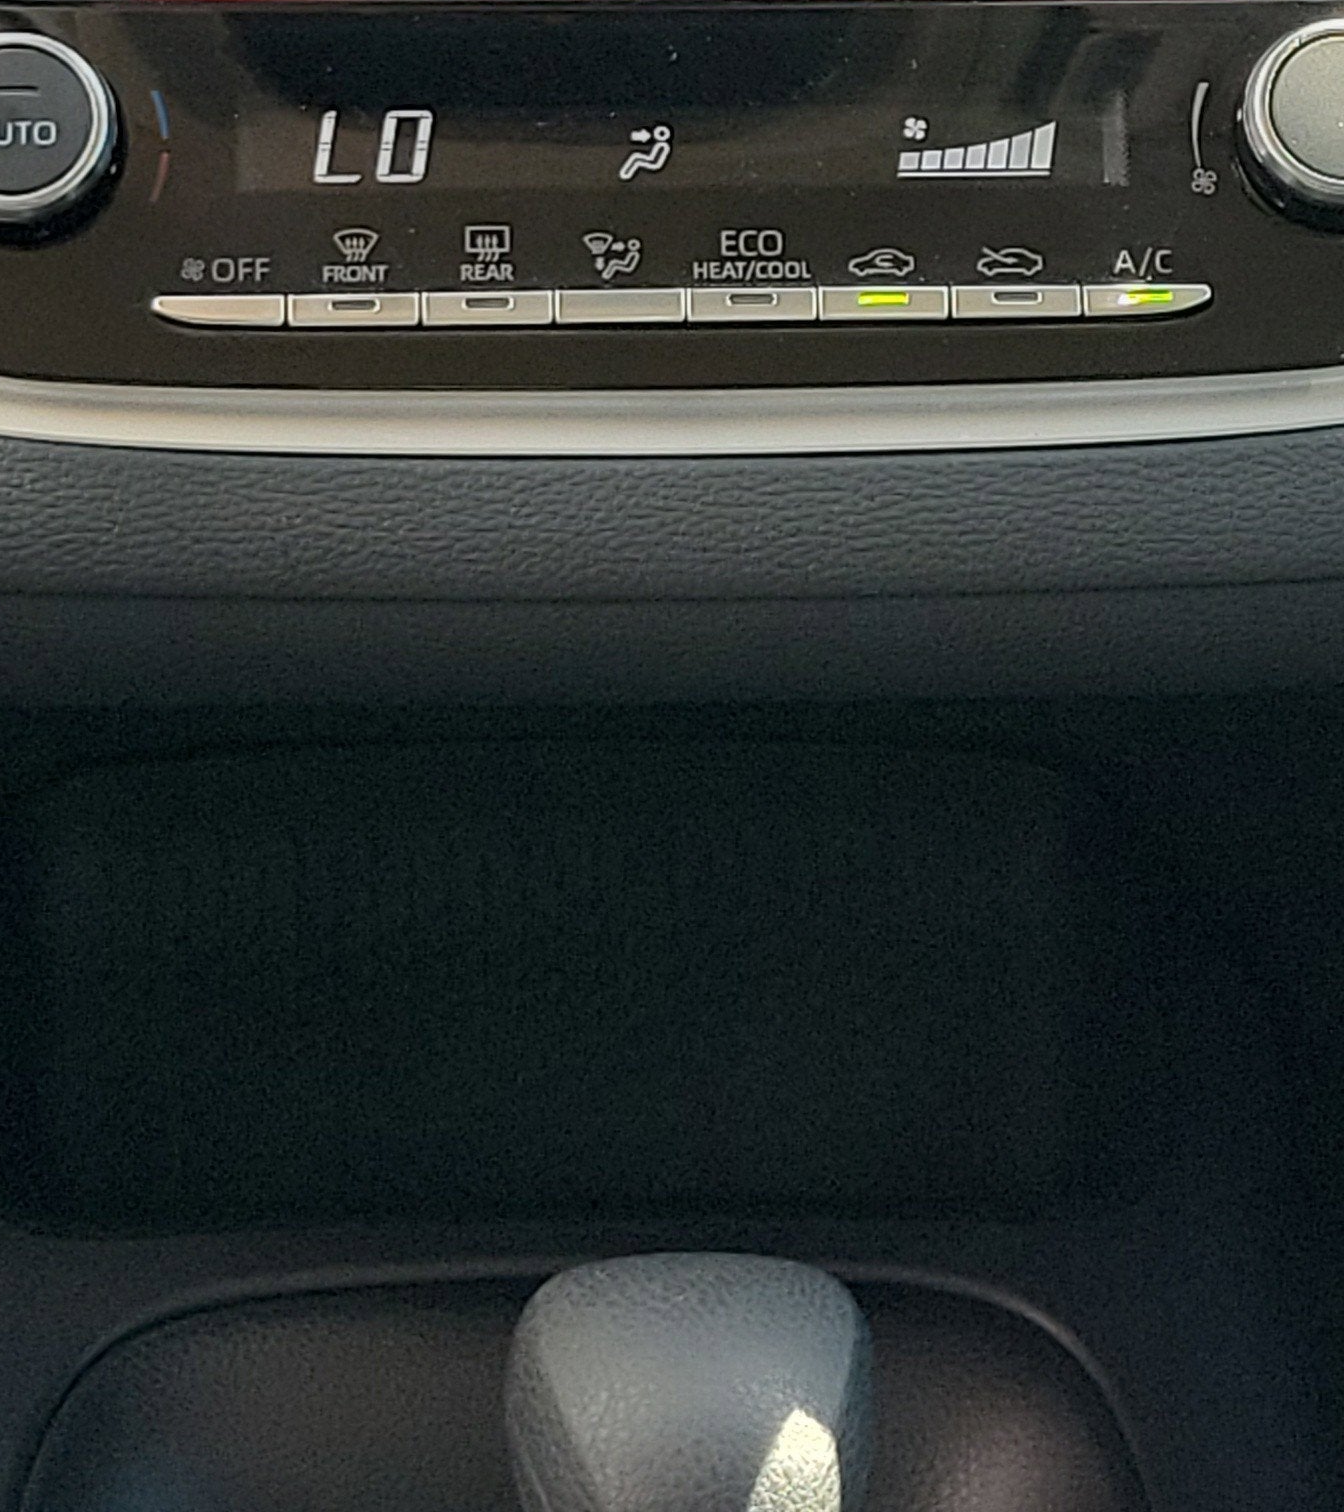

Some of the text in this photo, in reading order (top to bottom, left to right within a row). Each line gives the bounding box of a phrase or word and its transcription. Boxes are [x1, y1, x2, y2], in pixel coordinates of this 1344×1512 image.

[313, 109, 434, 184] LO
[720, 229, 784, 257] ECO
[211, 257, 271, 283] OFF
[322, 265, 389, 283] FRONT
[460, 263, 515, 281] REAR
[692, 260, 813, 282] HEAT/COOL
[1113, 247, 1174, 276] A/C
